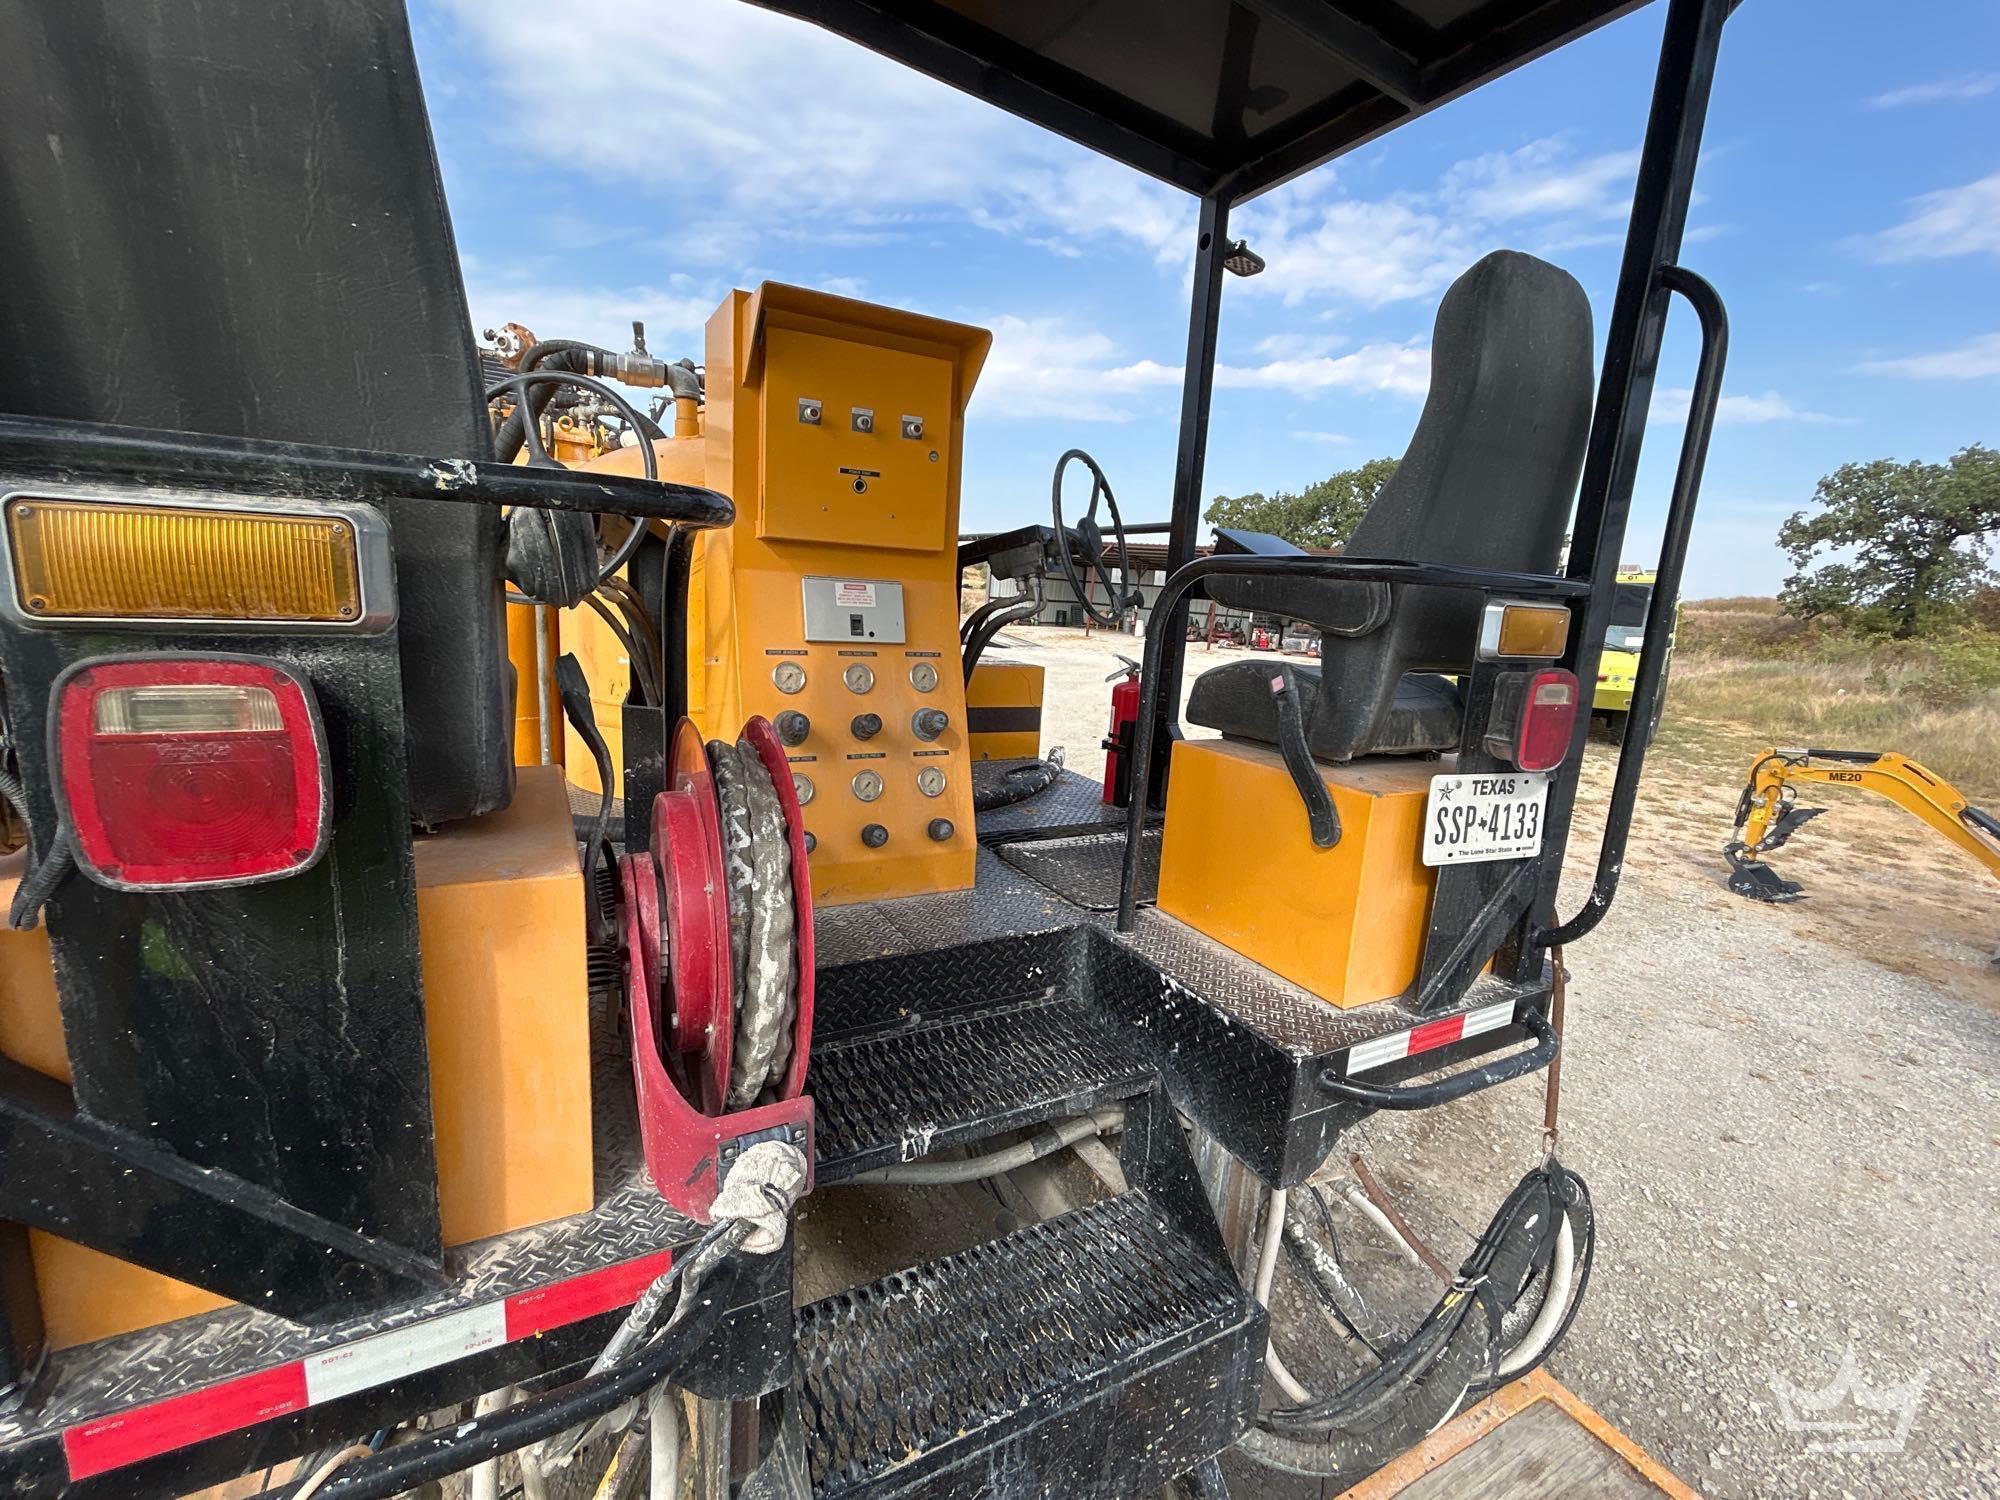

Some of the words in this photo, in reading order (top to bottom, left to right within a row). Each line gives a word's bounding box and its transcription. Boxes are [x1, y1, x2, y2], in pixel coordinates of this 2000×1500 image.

[1829, 773, 1862, 782] ME20
[1472, 779, 1516, 796] TEXAS
[1488, 802, 1540, 842] 4133
